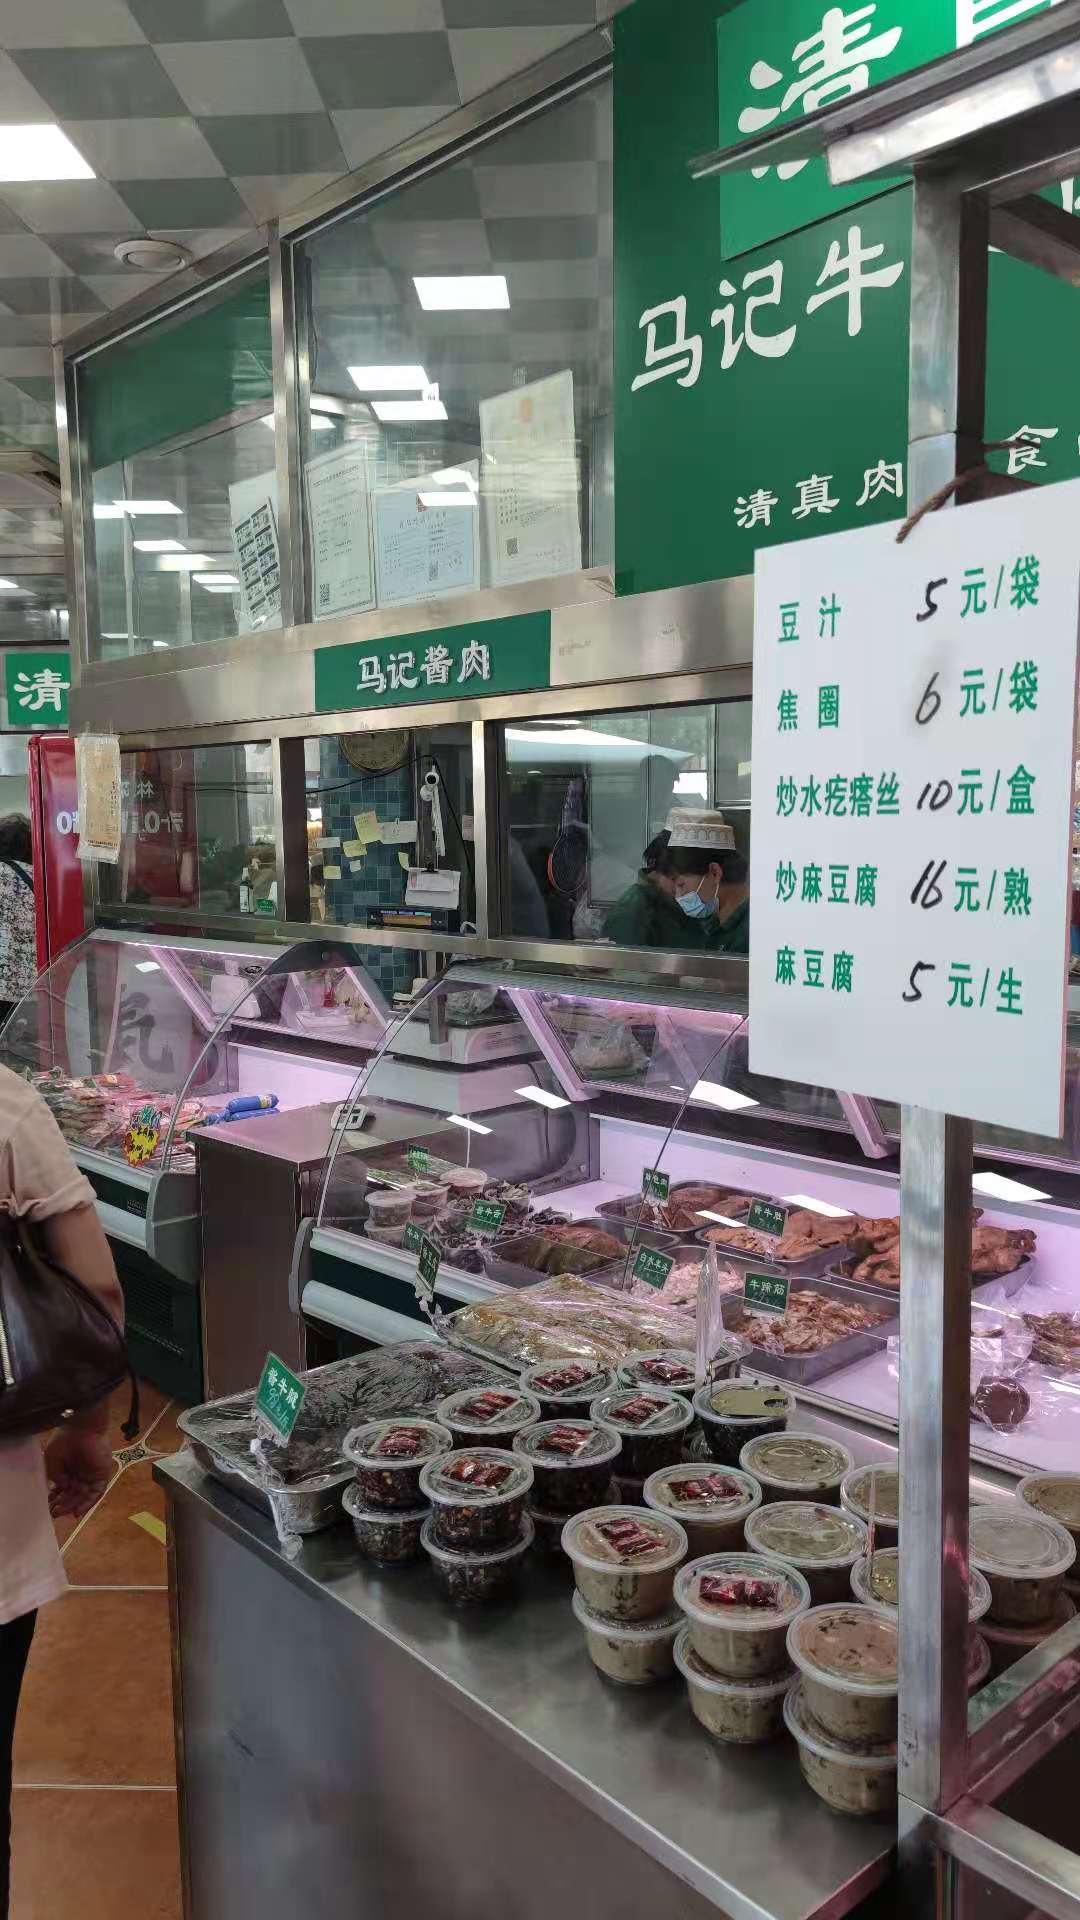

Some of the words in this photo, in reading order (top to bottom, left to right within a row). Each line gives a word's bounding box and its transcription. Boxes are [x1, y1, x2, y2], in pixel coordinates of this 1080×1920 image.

[631, 225, 904, 392] 马记牛
[733, 459, 904, 528] 清真肉
[1000, 425, 1080, 474] 食
[779, 593, 841, 643] 豆汁
[14, 668, 70, 711] 清
[357, 639, 491, 693] 马记酱肉
[777, 684, 840, 731] 焦圈
[776, 772, 900, 817] 炒水疙瘩丝
[776, 860, 878, 907] 炒麻豆腐
[775, 946, 854, 993] 麻豆腐
